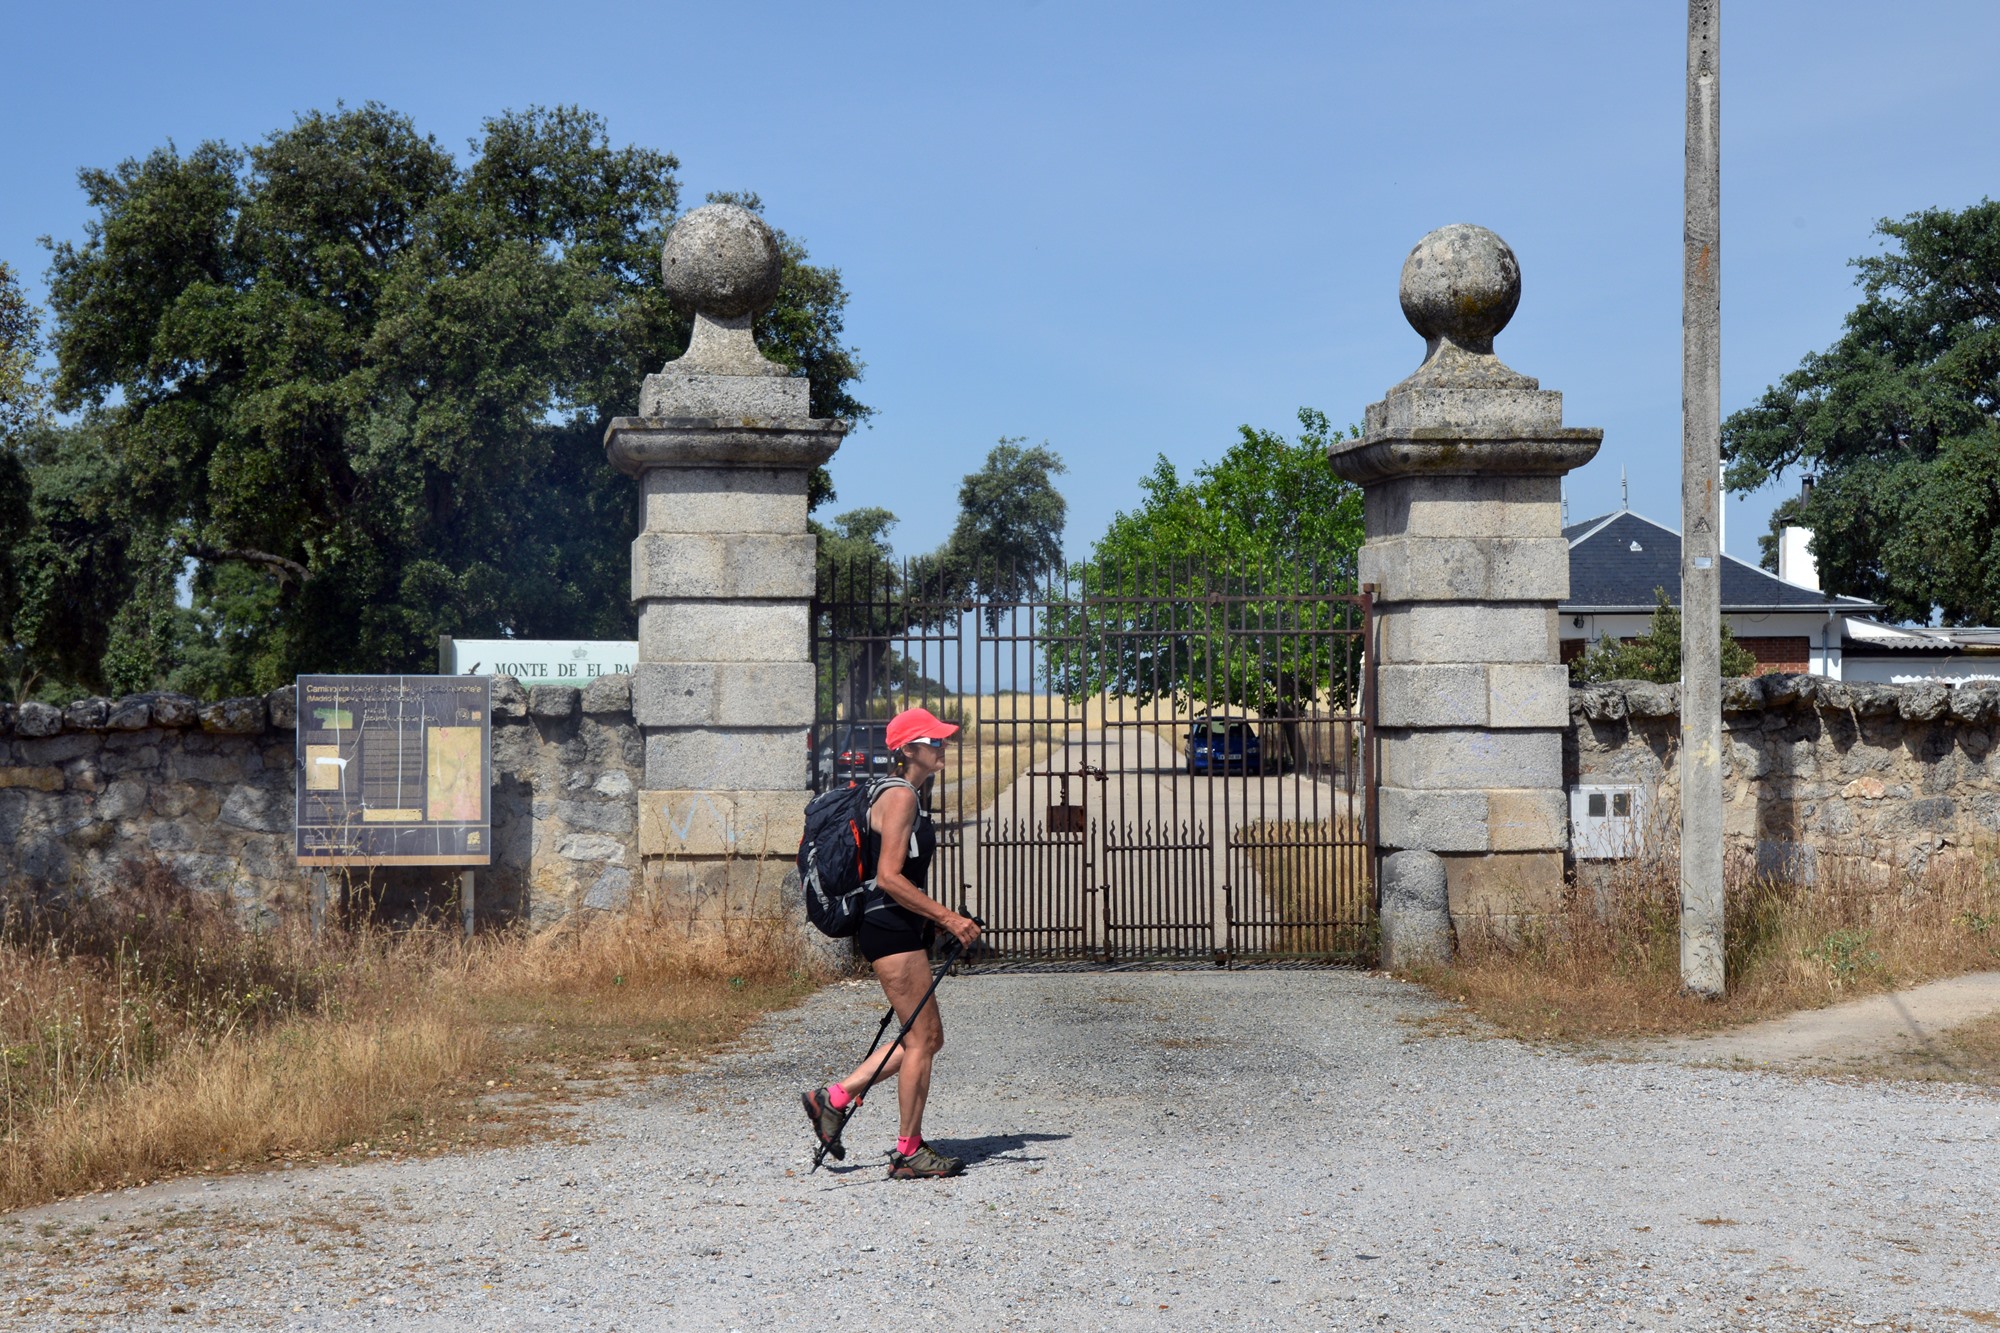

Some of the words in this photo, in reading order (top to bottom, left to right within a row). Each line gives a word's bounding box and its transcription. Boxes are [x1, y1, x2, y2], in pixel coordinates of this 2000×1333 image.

[494, 663, 548, 677] MONTE
[558, 663, 577, 677] DE
[587, 663, 606, 677] EL
